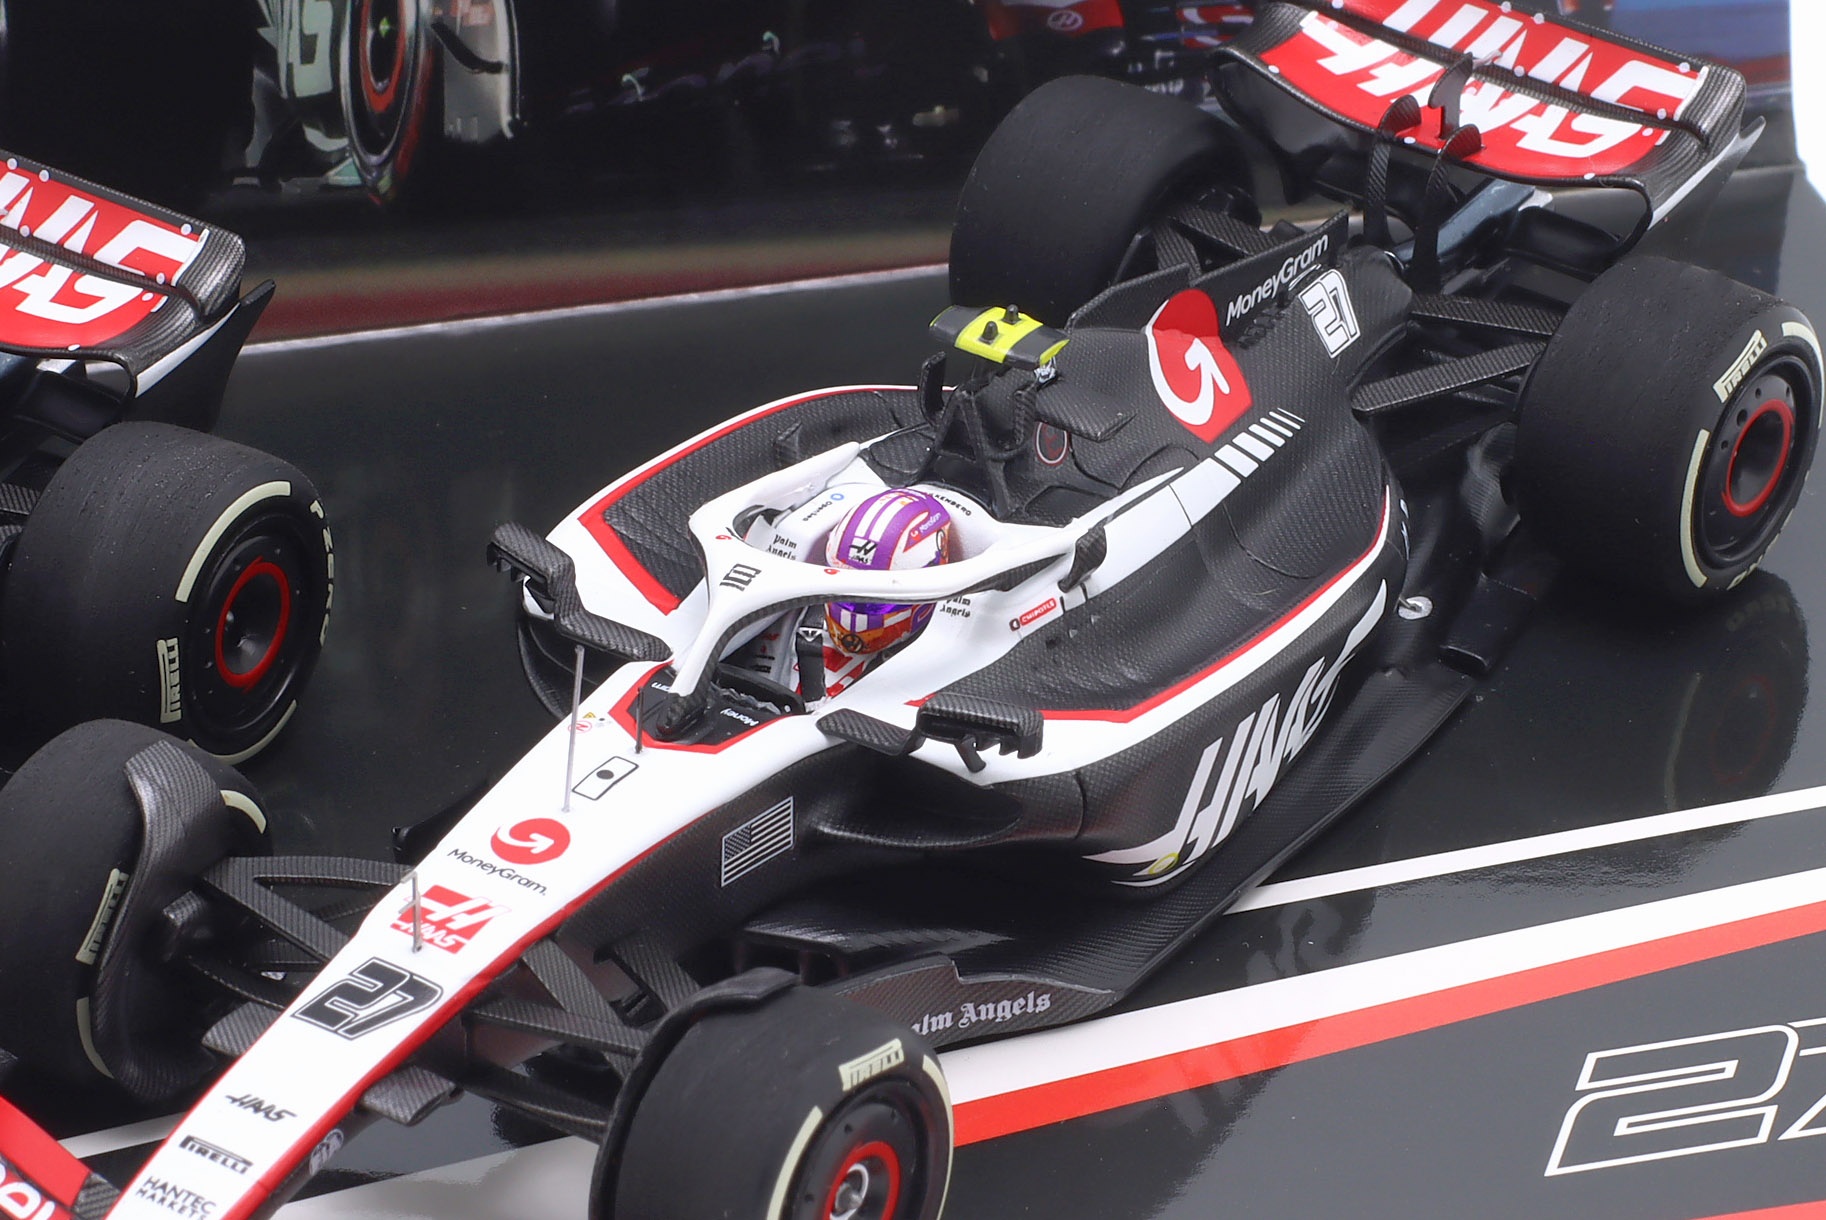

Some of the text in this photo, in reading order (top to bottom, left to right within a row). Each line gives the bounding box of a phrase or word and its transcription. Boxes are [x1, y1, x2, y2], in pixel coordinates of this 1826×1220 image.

[1225, 234, 1329, 327] MoneyGram
[1298, 268, 1361, 359] 27
[1712, 329, 1768, 403] PIRELLI
[156, 637, 182, 724] PIRELLI
[720, 708, 760, 727] Money
[290, 956, 444, 1041] 27
[959, 991, 1052, 1029] Angels
[838, 1038, 905, 1093] PIRELLI
[225, 1094, 297, 1122] HAAS
[178, 1135, 254, 1175] PIRELLI
[143, 1176, 217, 1215] HANTEC
